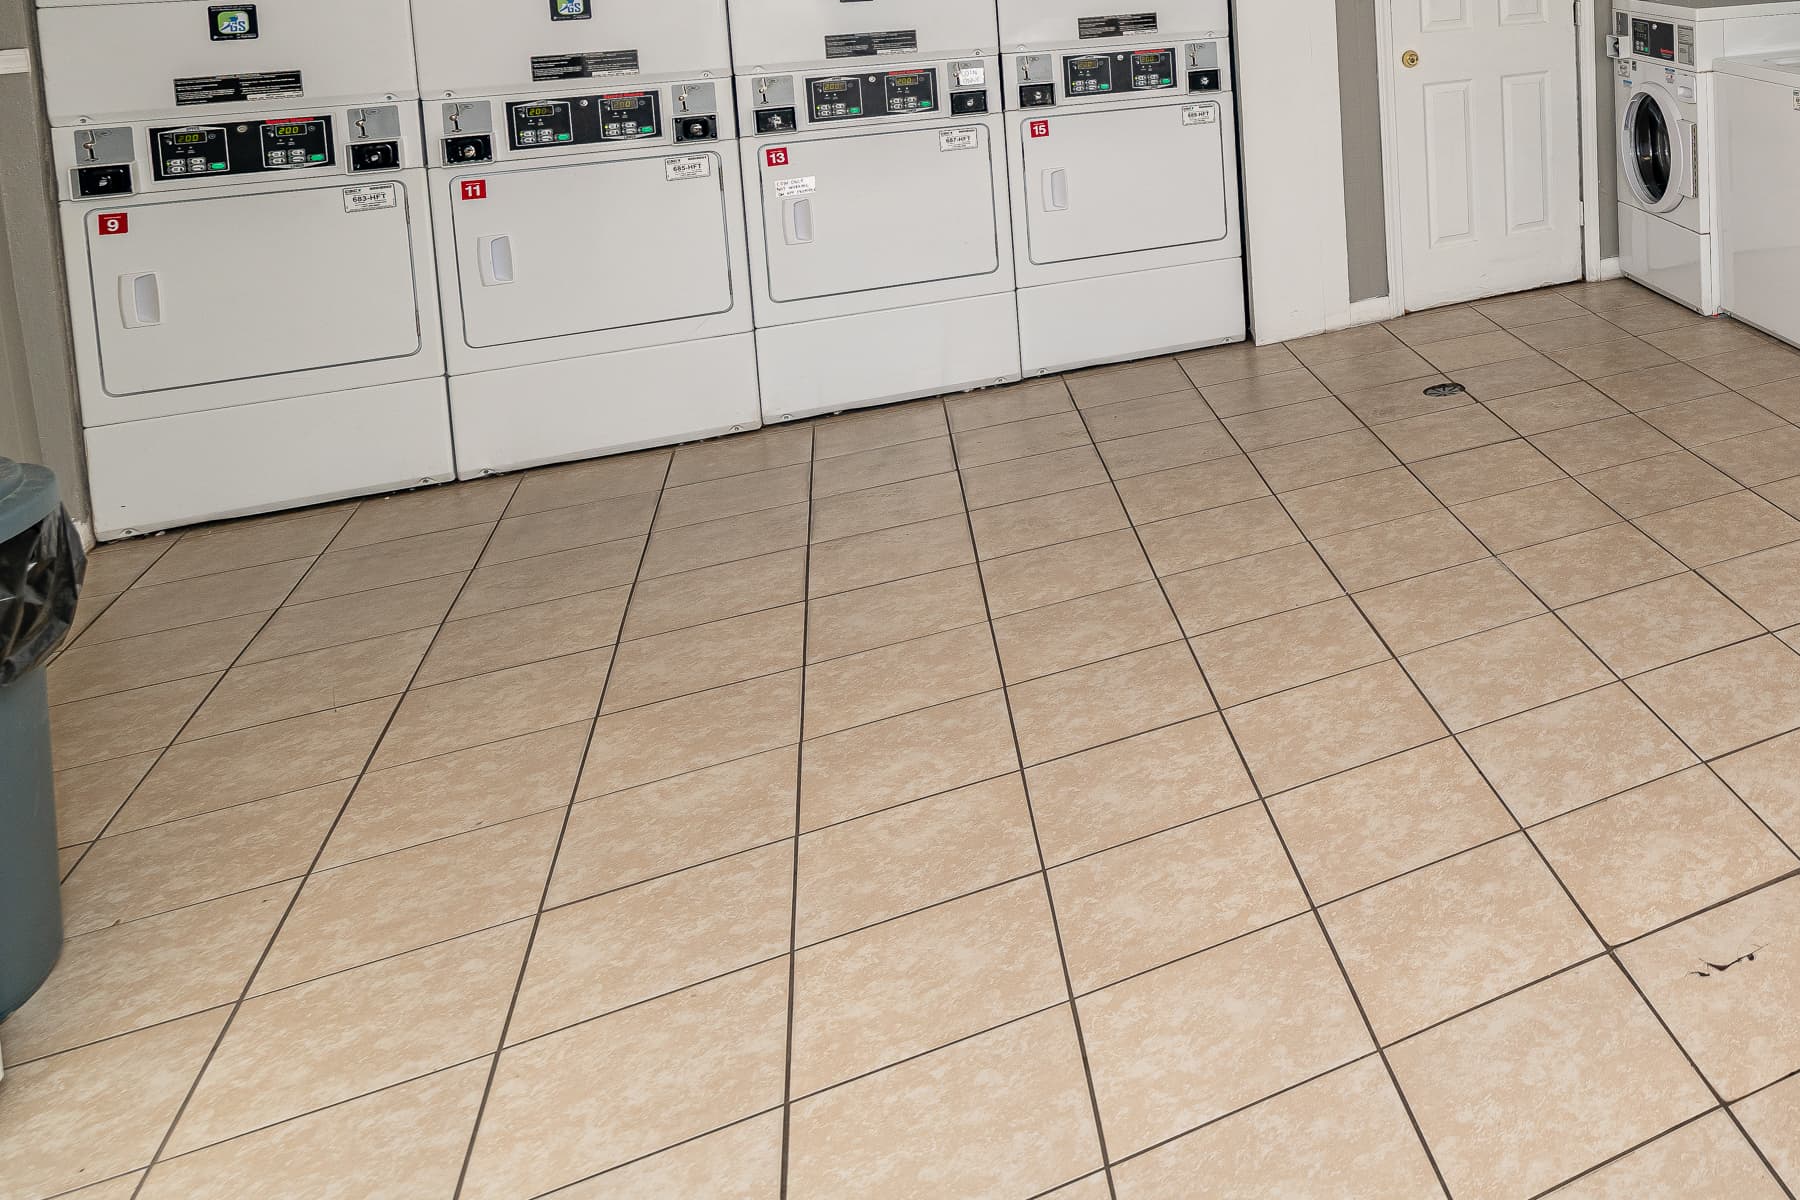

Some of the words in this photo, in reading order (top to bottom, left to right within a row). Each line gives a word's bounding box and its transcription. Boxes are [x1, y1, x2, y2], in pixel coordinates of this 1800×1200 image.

[230, 20, 246, 32] GS
[278, 126, 299, 134] 200
[1032, 124, 1046, 135] 15
[177, 134, 199, 142] 200
[769, 152, 785, 164] 13
[465, 184, 481, 197] 11
[352, 194, 386, 202] 683-HFT
[107, 219, 119, 232] 9
